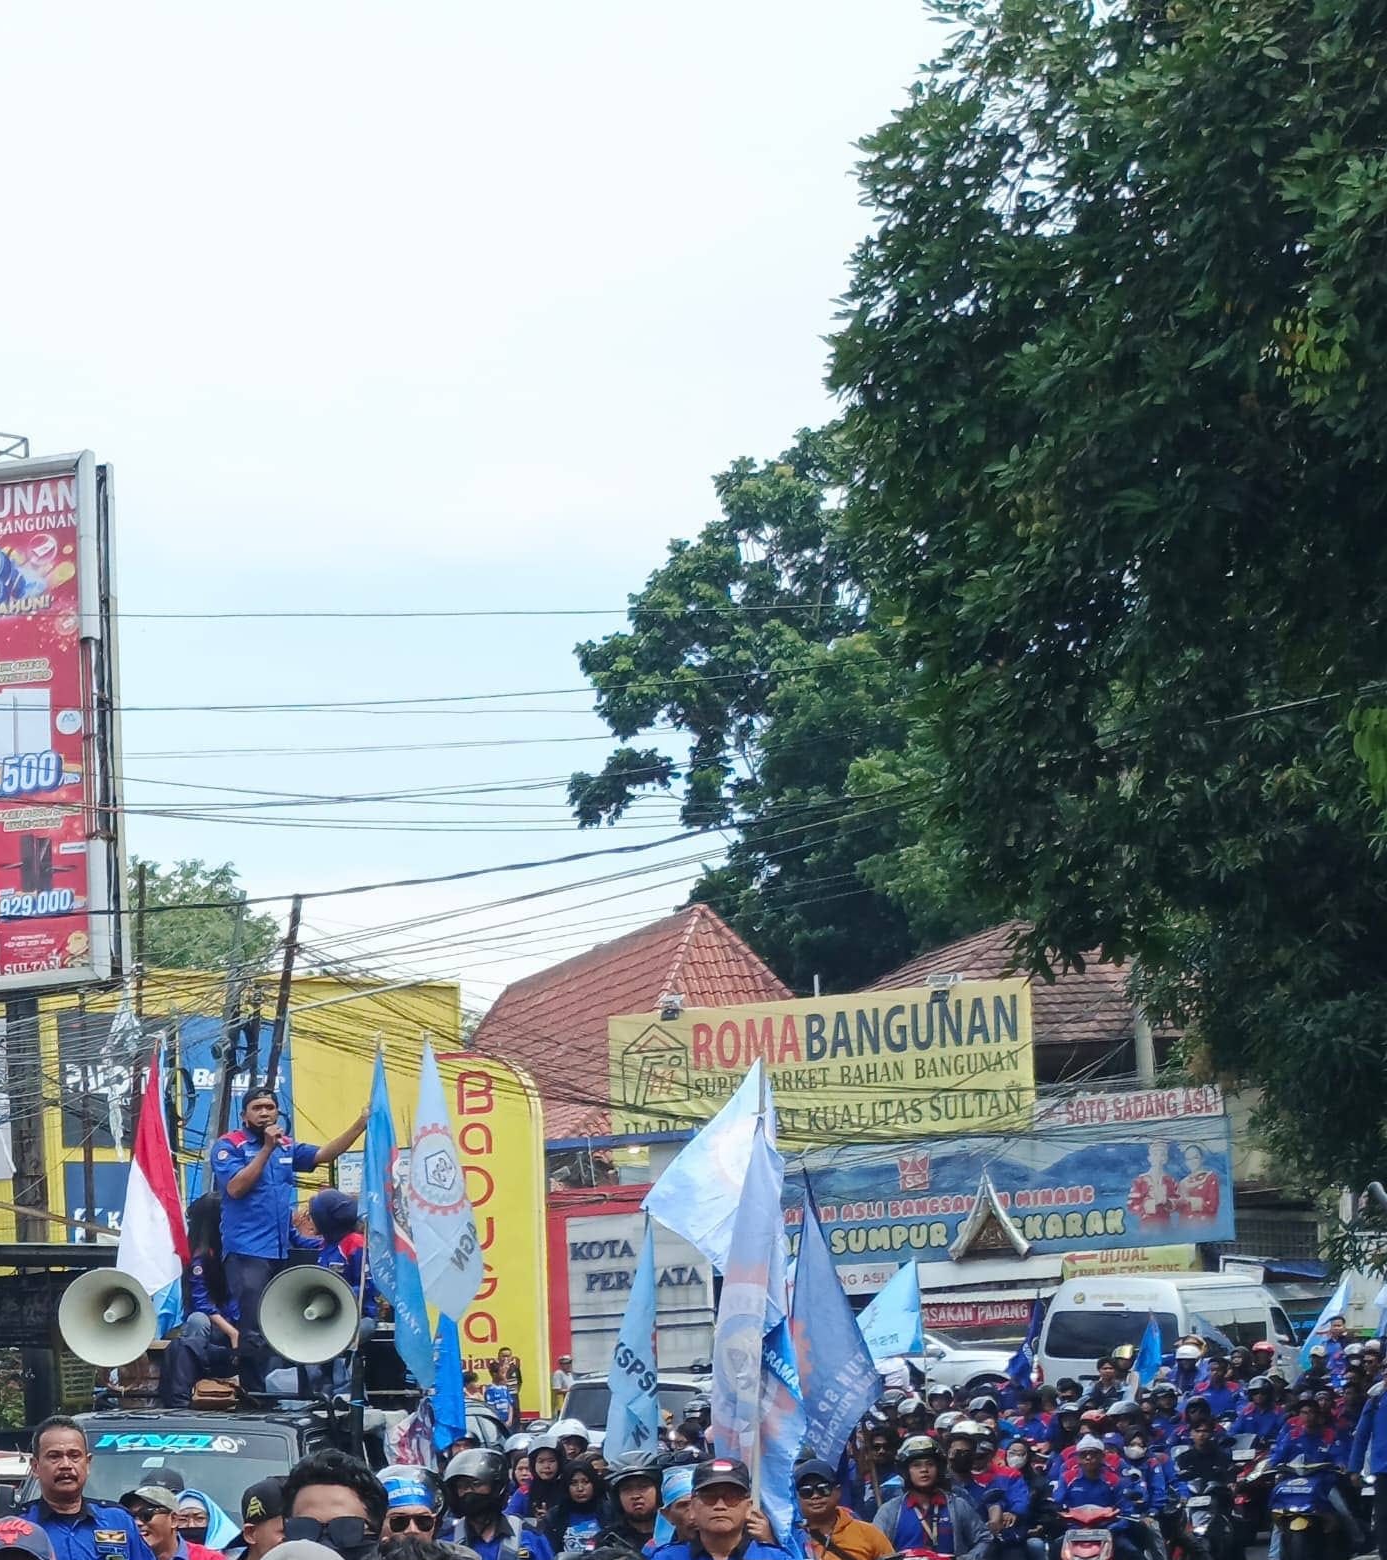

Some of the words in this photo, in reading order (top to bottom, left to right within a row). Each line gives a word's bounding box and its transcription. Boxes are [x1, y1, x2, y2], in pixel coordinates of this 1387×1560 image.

[4, 957, 60, 977] SULTAN
[693, 1066, 830, 1100] SUPEARKET
[840, 1061, 904, 1087] BAHAN
[914, 1050, 1019, 1080] BANGUNAN
[810, 1097, 924, 1132] KUALITAS
[930, 1085, 1024, 1123] SULTAN
[1065, 1098, 1108, 1125] SOTO
[841, 1200, 884, 1222] ASLI
[1015, 1184, 1095, 1208] MINANG
[569, 1239, 636, 1261] KOTA
[830, 1221, 948, 1255] SUMPUR
[1099, 1248, 1149, 1264] DIJUAL
[585, 1266, 705, 1292] PERATA
[922, 1305, 973, 1323] ASAKAN
[977, 1303, 1029, 1322] PADANG
